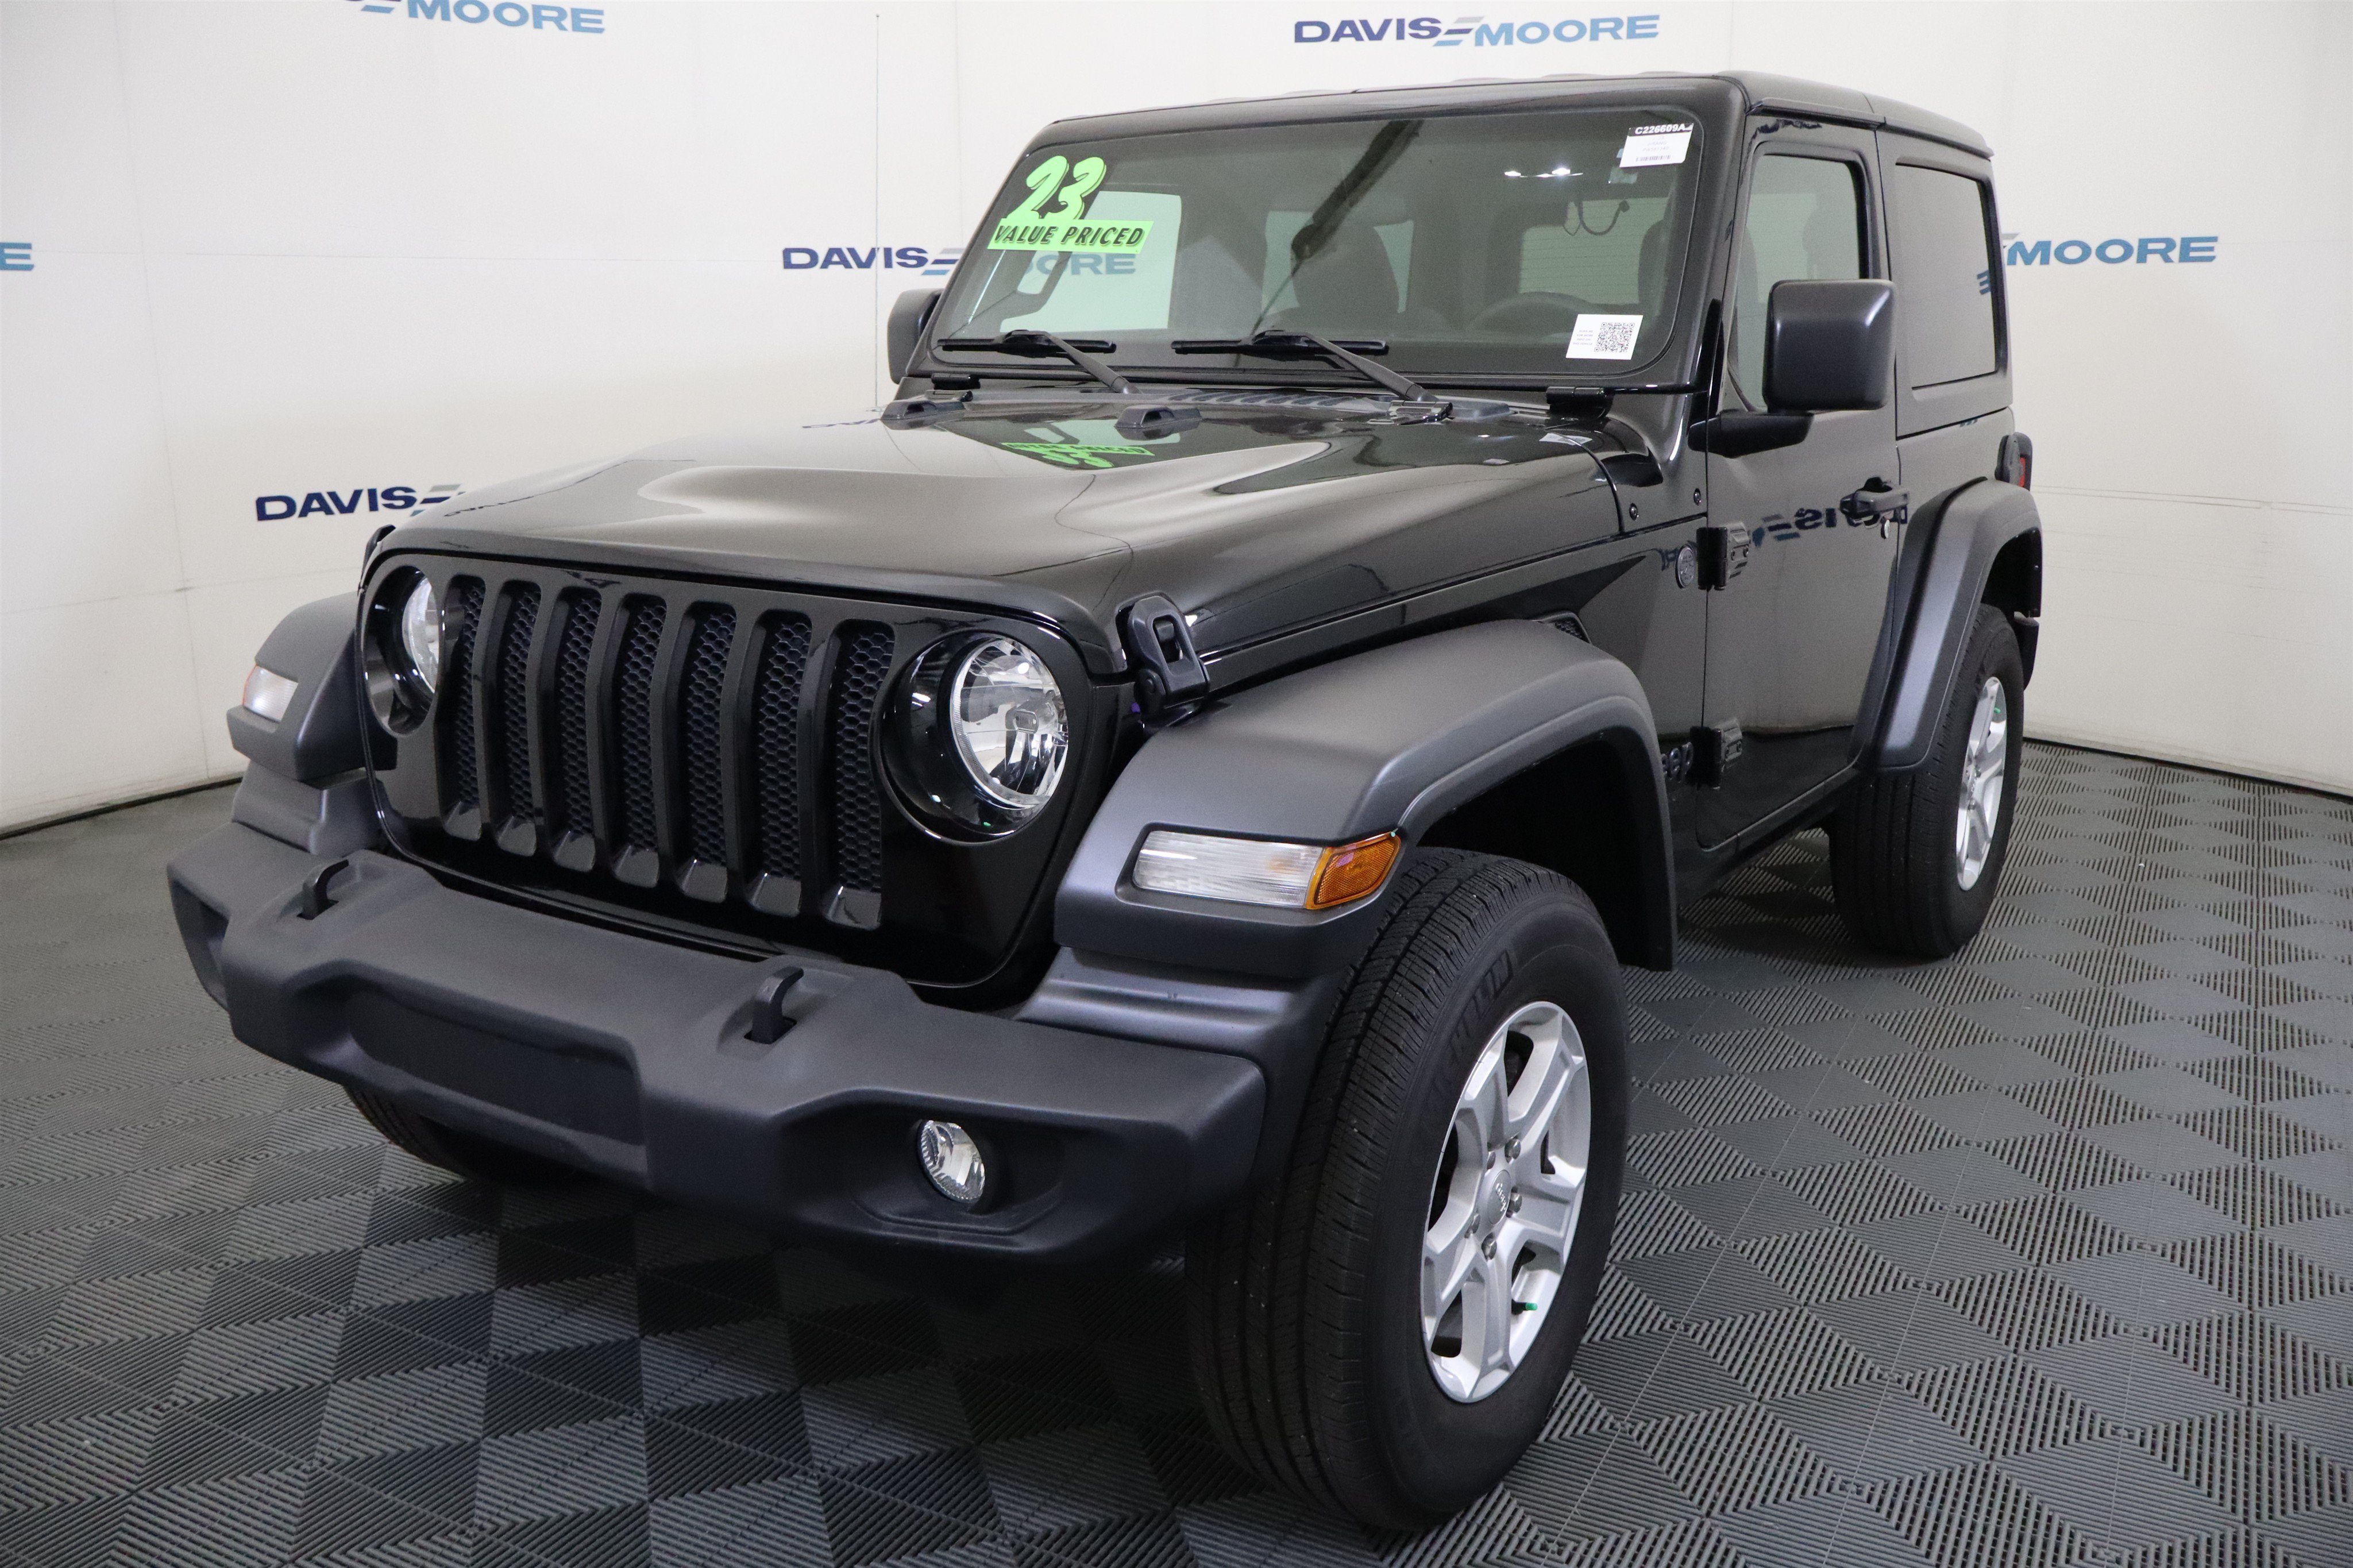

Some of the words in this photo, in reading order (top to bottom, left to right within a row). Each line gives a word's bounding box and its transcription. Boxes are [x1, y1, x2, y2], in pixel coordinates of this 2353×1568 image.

[407, 0, 605, 34] MOORE
[1294, 17, 1442, 43] DAVIS
[1475, 14, 1660, 47] MOORE
[1635, 123, 1686, 134] C226609A
[1006, 155, 1107, 220] 23
[994, 225, 1058, 245] VALUE
[1060, 226, 1146, 246] PRICED
[2007, 235, 2219, 266] MOORE
[782, 247, 928, 269] DAVIS
[1026, 253, 1136, 275] ORE
[255, 486, 418, 521] DAVIS
